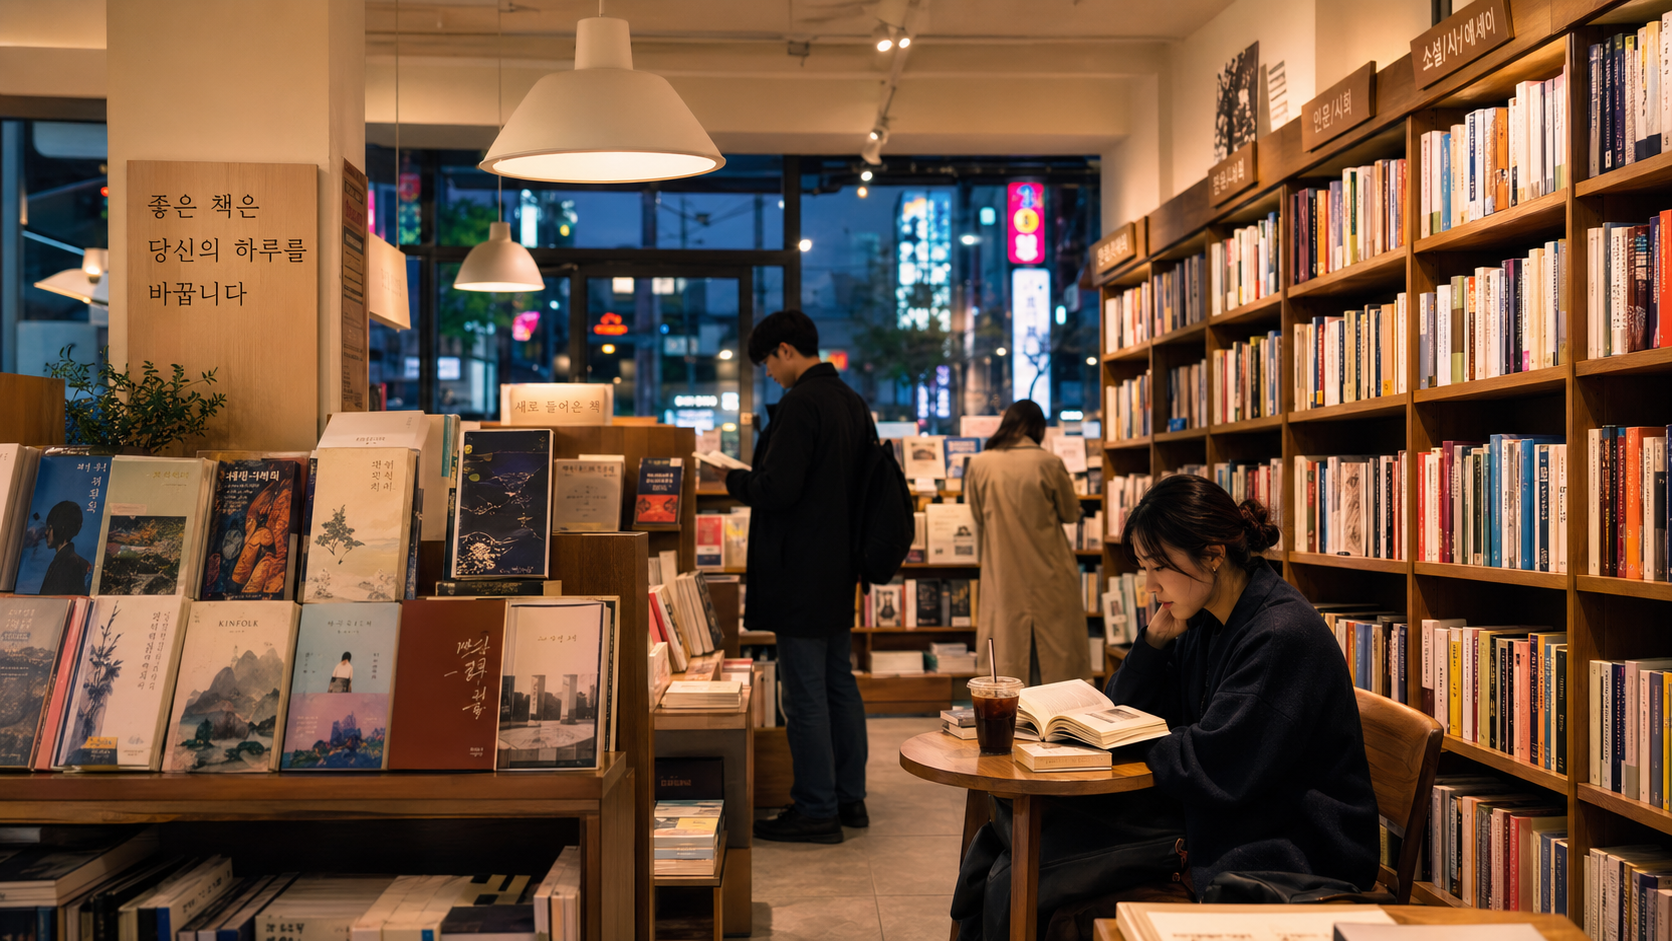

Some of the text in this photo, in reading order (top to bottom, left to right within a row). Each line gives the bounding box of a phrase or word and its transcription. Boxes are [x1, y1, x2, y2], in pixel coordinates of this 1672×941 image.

[147, 193, 260, 219] 좋은 책은
[148, 237, 307, 263] 당신의 하루를
[148, 281, 247, 307] 바꿉니다
[515, 400, 539, 414] 새로
[589, 400, 600, 414] 책
[218, 620, 259, 628] KINFOLK
